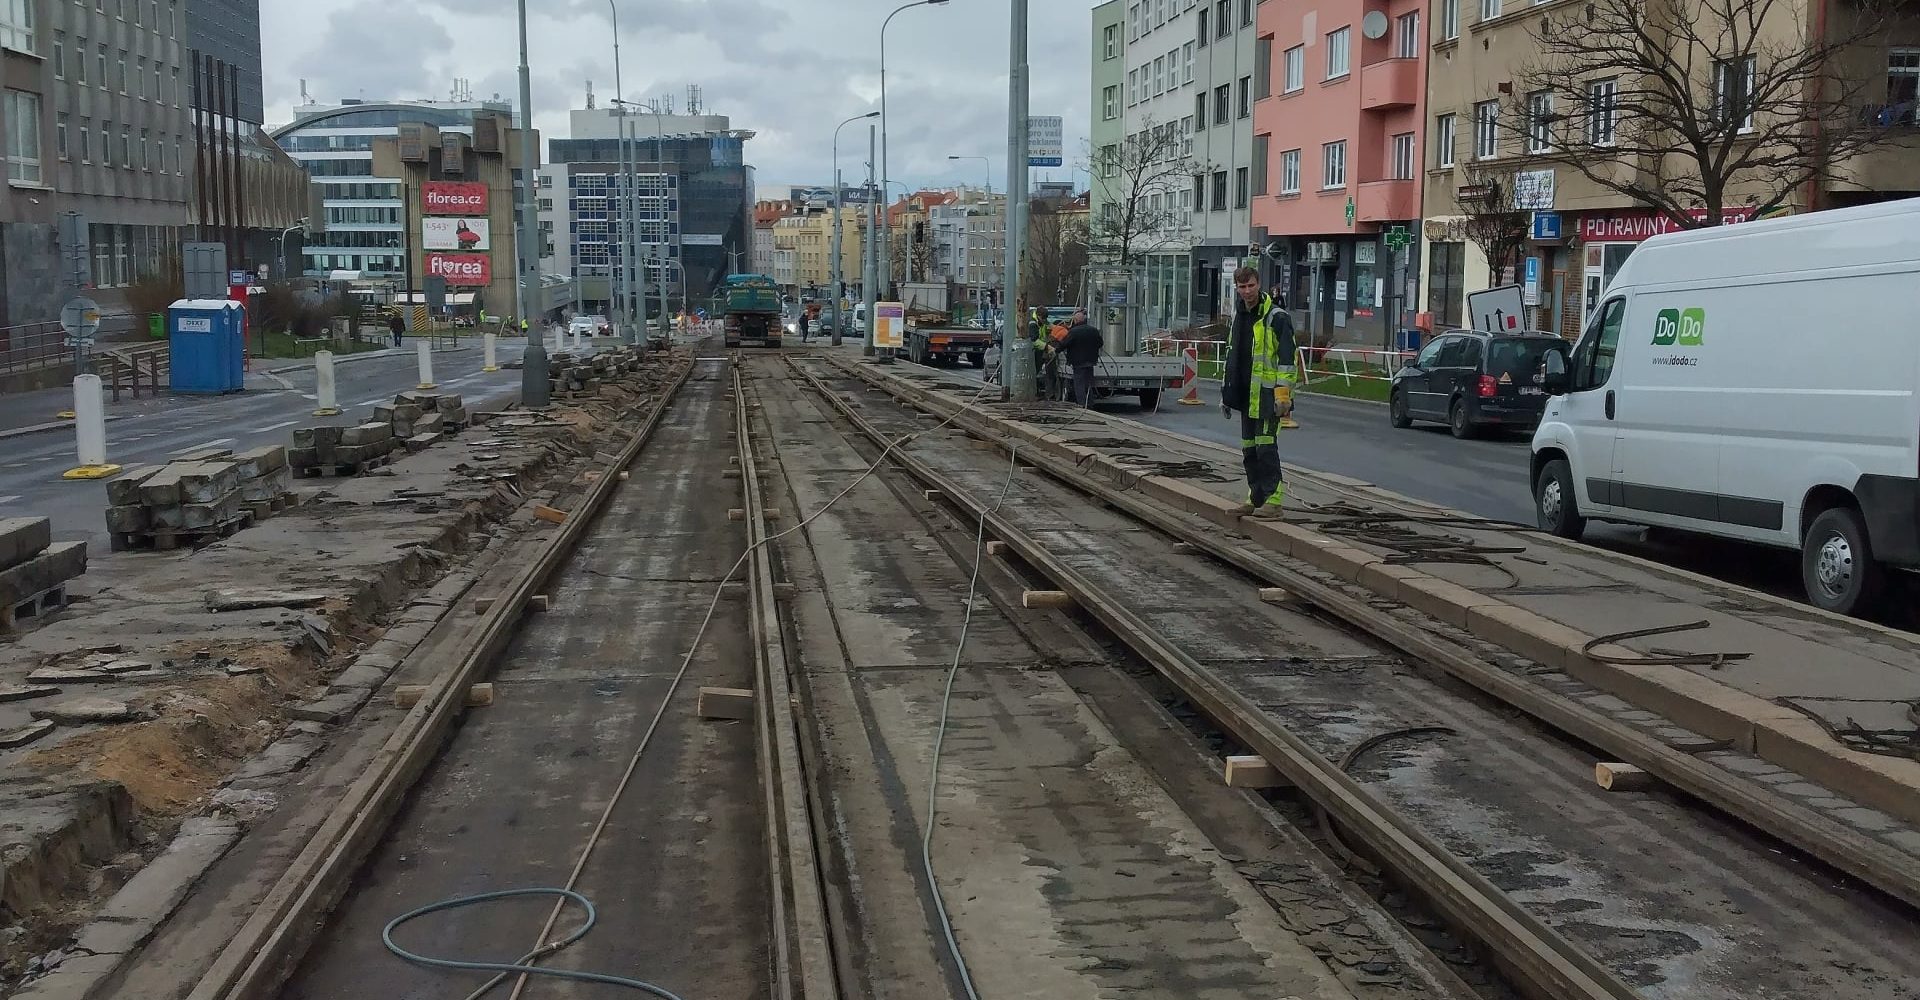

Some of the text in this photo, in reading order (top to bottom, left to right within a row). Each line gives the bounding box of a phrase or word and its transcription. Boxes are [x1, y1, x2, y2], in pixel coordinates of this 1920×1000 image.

[427, 192, 481, 204] florea.cz
[1586, 216, 1669, 237] POTRAVINY
[431, 256, 482, 274] florea
[1652, 354, 1698, 367] www.idodo.cz
